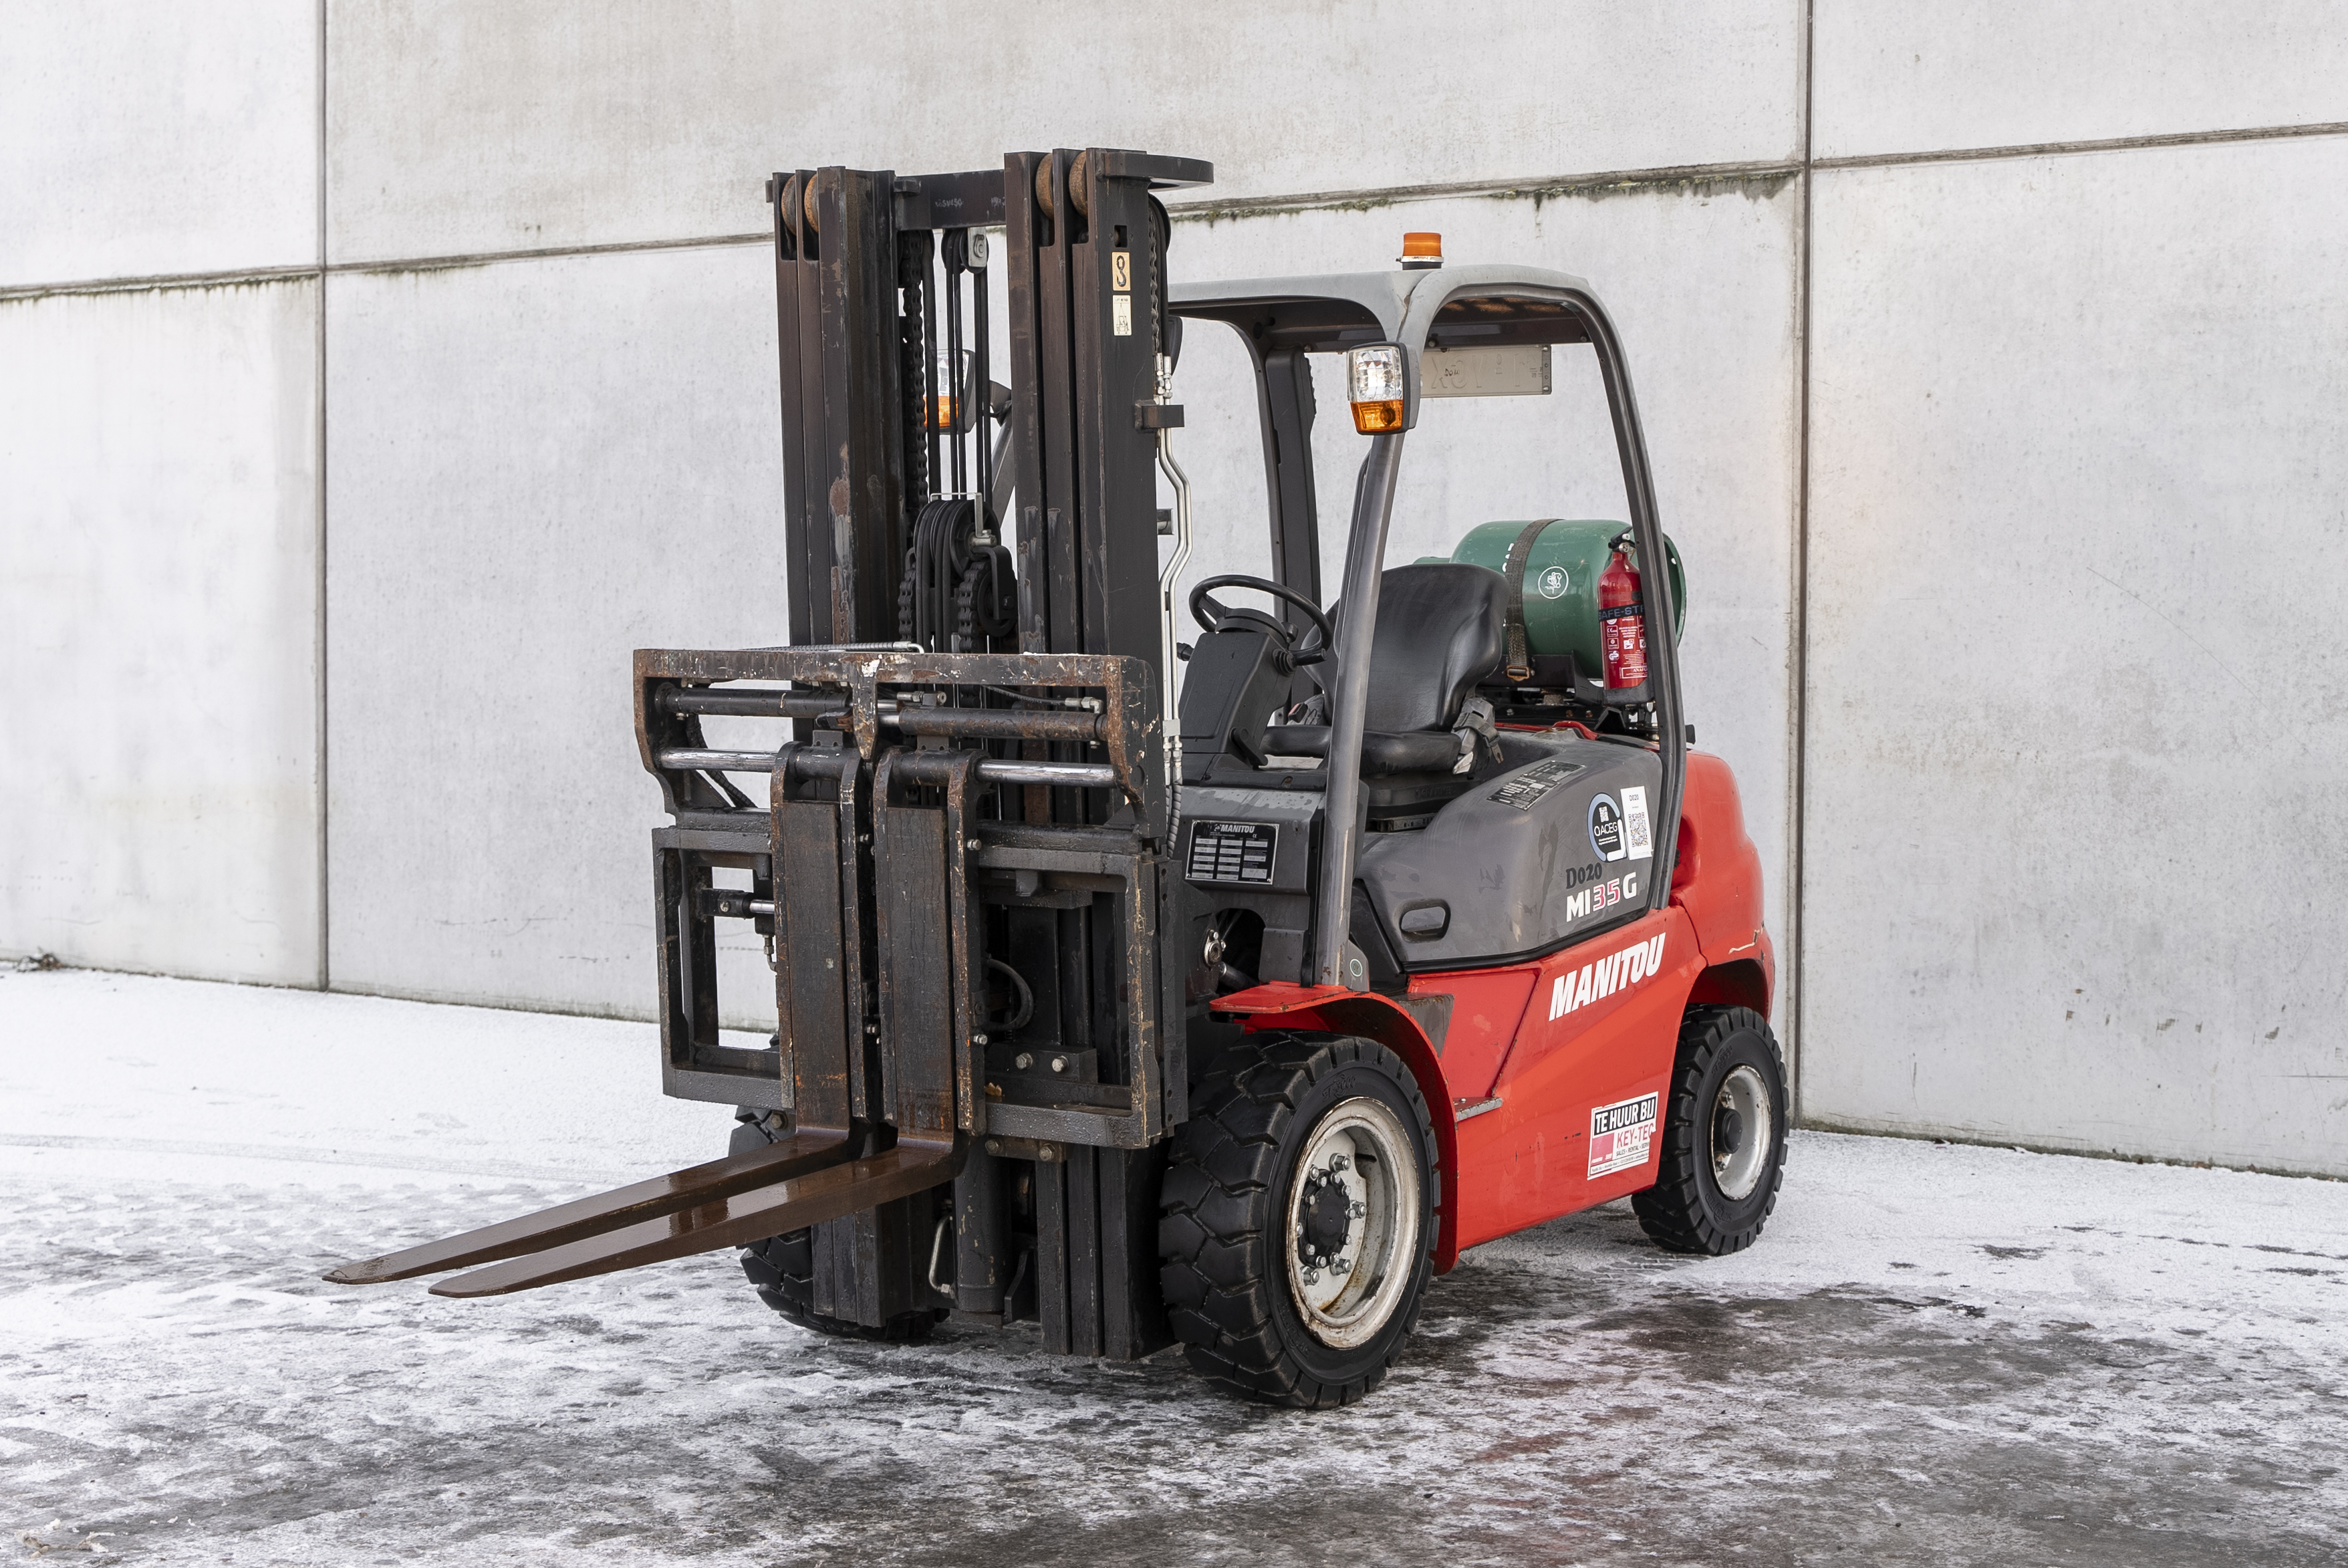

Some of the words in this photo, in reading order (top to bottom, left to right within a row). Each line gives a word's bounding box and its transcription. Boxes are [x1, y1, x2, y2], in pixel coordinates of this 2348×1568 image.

[1220, 824, 1255, 833] MANITOU
[1565, 862, 1603, 890] D020
[1548, 932, 1666, 1022] MANITOU
[1595, 1112, 1608, 1134] TE
[1609, 1103, 1639, 1130] HUUR
[1640, 1099, 1655, 1121] BIJ
